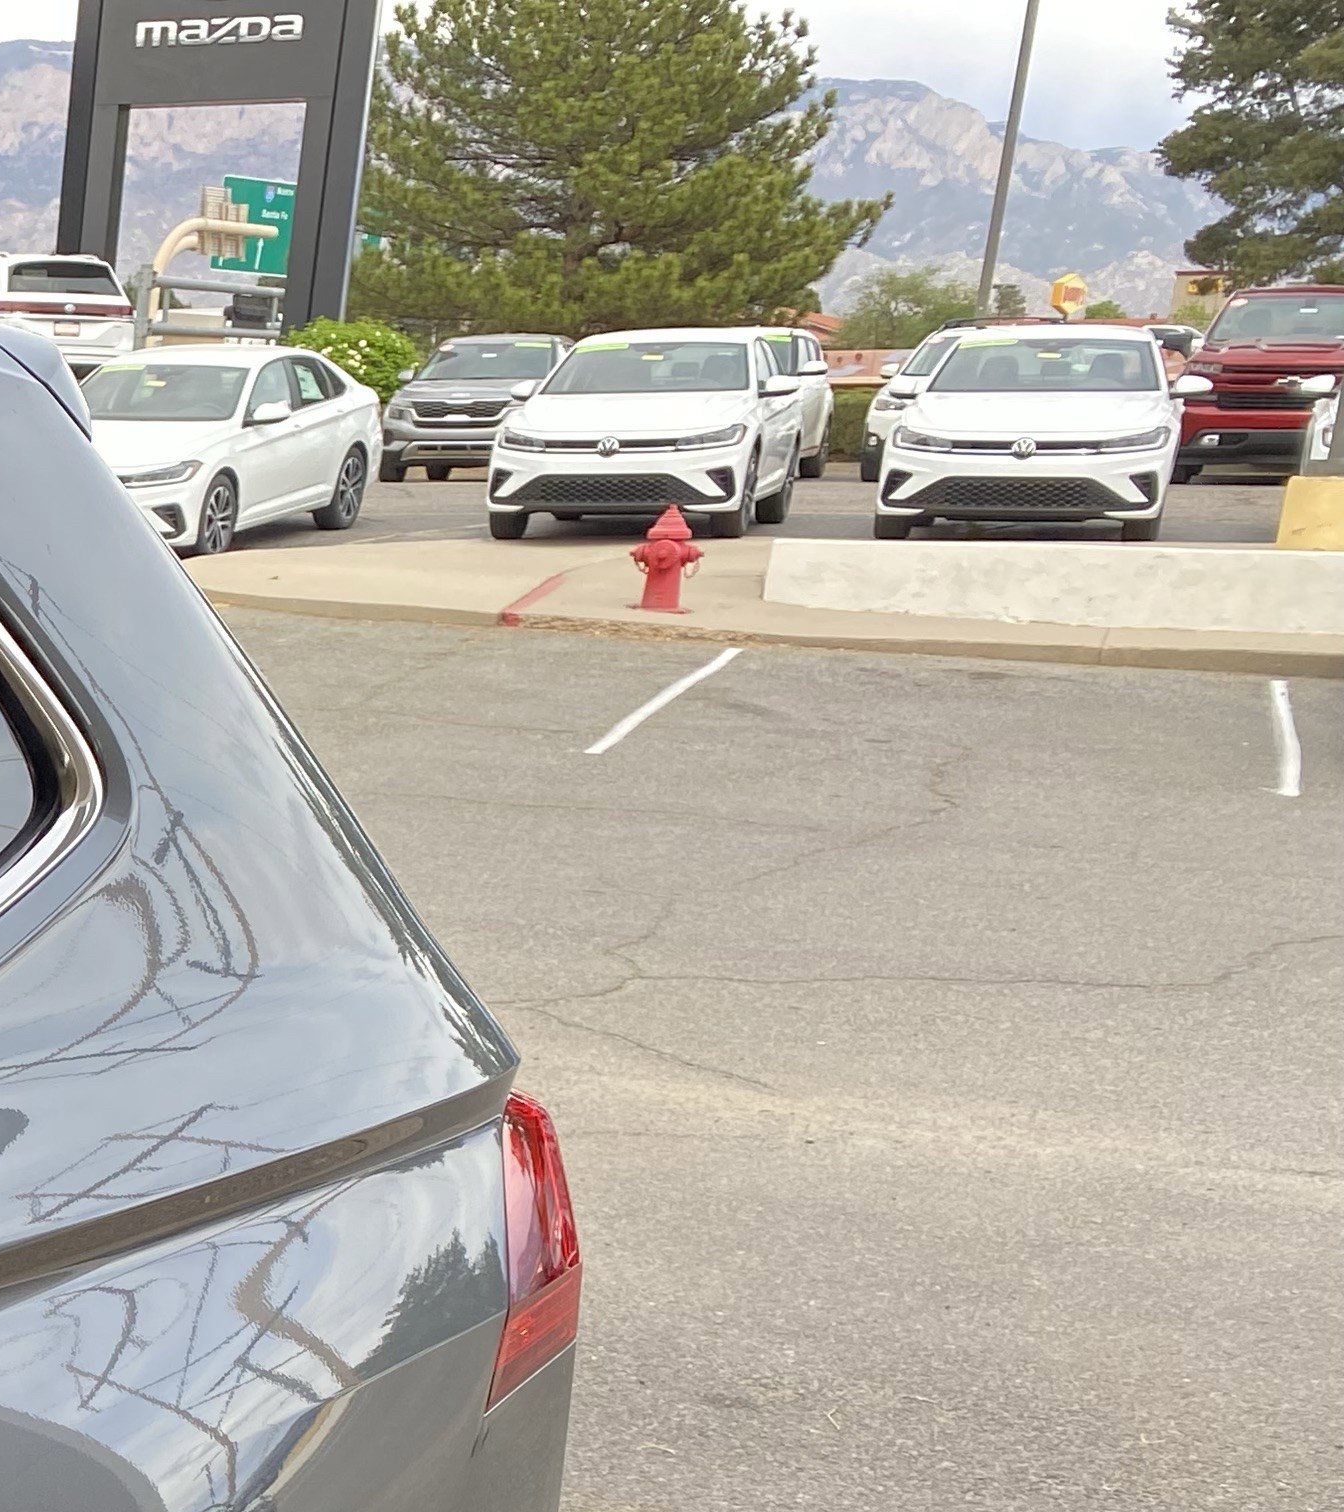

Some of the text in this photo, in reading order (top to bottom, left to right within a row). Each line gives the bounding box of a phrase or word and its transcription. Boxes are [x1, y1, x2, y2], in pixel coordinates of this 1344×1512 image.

[135, 13, 304, 48] mazda
[261, 209, 289, 220] Santa Fe
